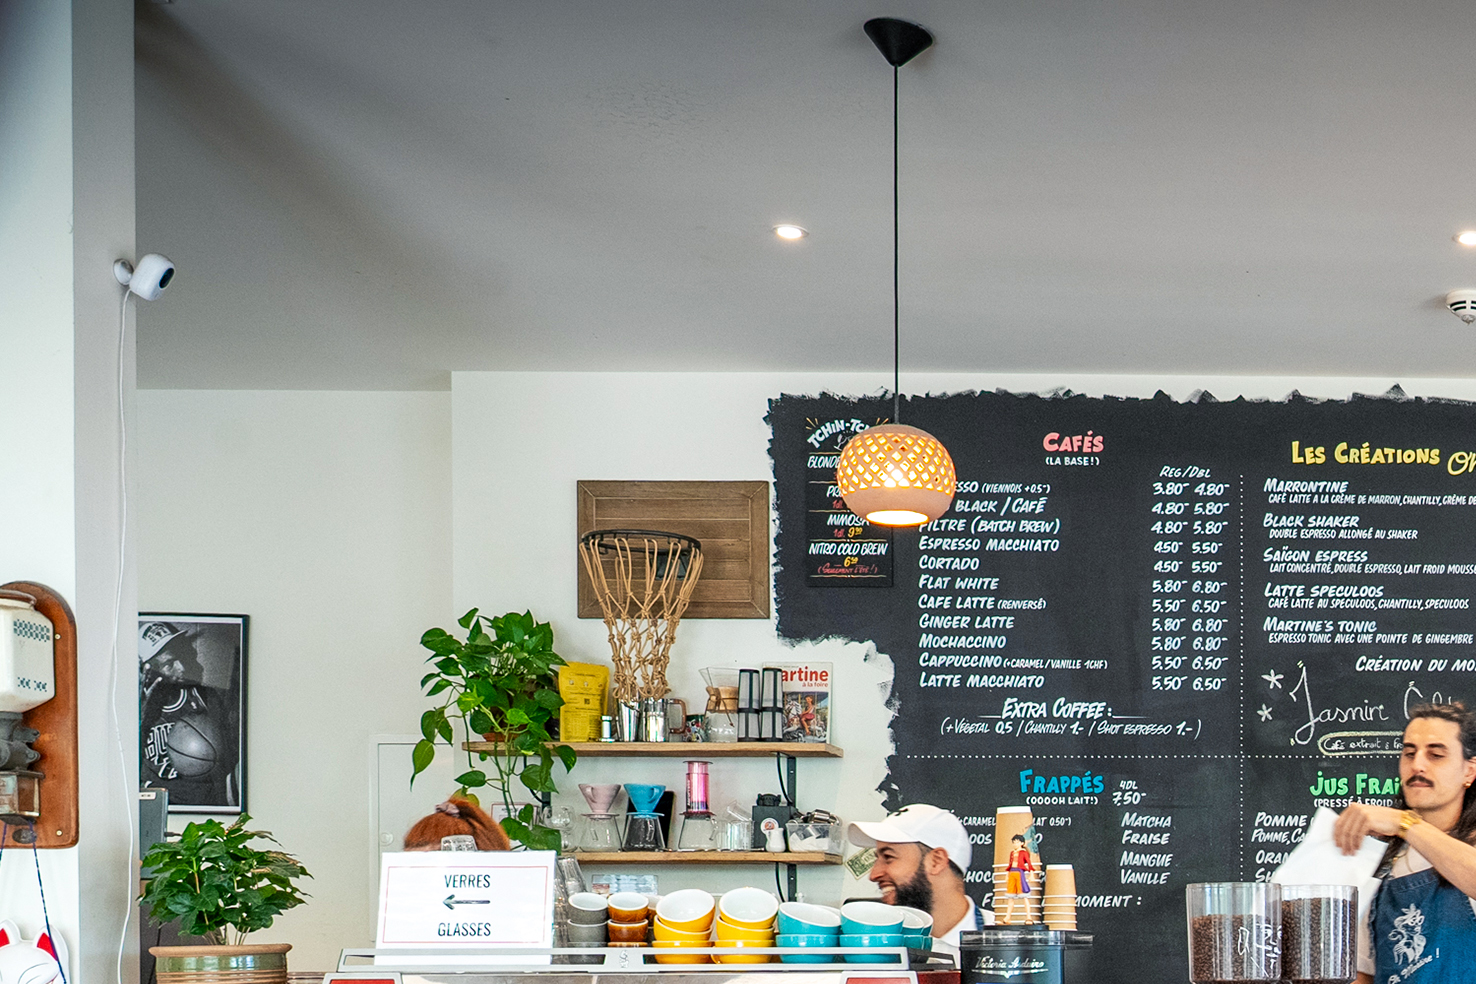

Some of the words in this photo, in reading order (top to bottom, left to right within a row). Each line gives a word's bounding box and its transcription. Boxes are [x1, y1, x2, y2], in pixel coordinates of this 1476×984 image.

[1043, 431, 1103, 452] CAFÉS
[1292, 441, 1325, 464] LES
[1335, 442, 1440, 465] CRÉATIONS
[1264, 478, 1348, 494] MARRONTINE
[955, 500, 998, 512] BLACK
[1012, 497, 1047, 514] CAFÉ
[971, 517, 1016, 534] (BATCH
[1019, 519, 1060, 534] BREW)
[1263, 513, 1304, 527] BLACK
[1308, 516, 1359, 527] SHAKER
[1269, 529, 1297, 538] DOUBLE
[1300, 529, 1336, 539] ESPRESSO
[1338, 527, 1373, 539] ALLONGÉ
[1375, 530, 1386, 539] AU
[1387, 530, 1418, 539] SHAKER
[809, 543, 836, 555] NITRO
[838, 543, 860, 555] COLD
[861, 543, 888, 555] BREW
[919, 536, 980, 550] ESPRESSO
[986, 539, 1059, 551] MACCHIATO
[1264, 546, 1310, 562] SAÏGON
[1315, 551, 1367, 562] ESPRESS
[919, 555, 979, 570] CORTADO
[1423, 565, 1445, 574] FROID
[919, 575, 949, 589] FLAT
[955, 577, 999, 589] WHITE
[1264, 582, 1305, 598] LATTE
[1310, 585, 1384, 597] SPECULOOS
[918, 594, 950, 608] CAFE
[956, 597, 995, 609] LATTE
[998, 598, 1046, 609] (RENVERSÉ)
[919, 614, 970, 628] GINGER
[975, 616, 1014, 628] LATTE
[1263, 617, 1333, 632] MARTINE'S
[1338, 621, 1377, 632] TONIC
[919, 633, 1006, 648] MOCHACCINO
[1376, 634, 1408, 643] POINTE
[1412, 634, 1422, 644] DE
[1425, 634, 1473, 644] GINGEMBRE
[919, 652, 1002, 667] CAPPUCCINO
[1356, 655, 1423, 671] CRÉATION
[1428, 659, 1446, 671] DU
[782, 666, 828, 682] artine
[920, 672, 961, 687] LATTE
[967, 675, 1044, 687] MACCHIATO
[1002, 698, 1047, 719] EXTRA
[1123, 724, 1172, 735] ESPRESSO
[1020, 769, 1104, 793] FRAPPÉS
[1120, 780, 1138, 789] 4DL
[1121, 812, 1171, 828] MATCHA
[1122, 830, 1170, 844] FRAISE
[1120, 852, 1173, 867] MANGUE
[445, 875, 490, 888] VERRES
[1121, 869, 1168, 884] VANILLE
[438, 923, 490, 936] GLASSES
